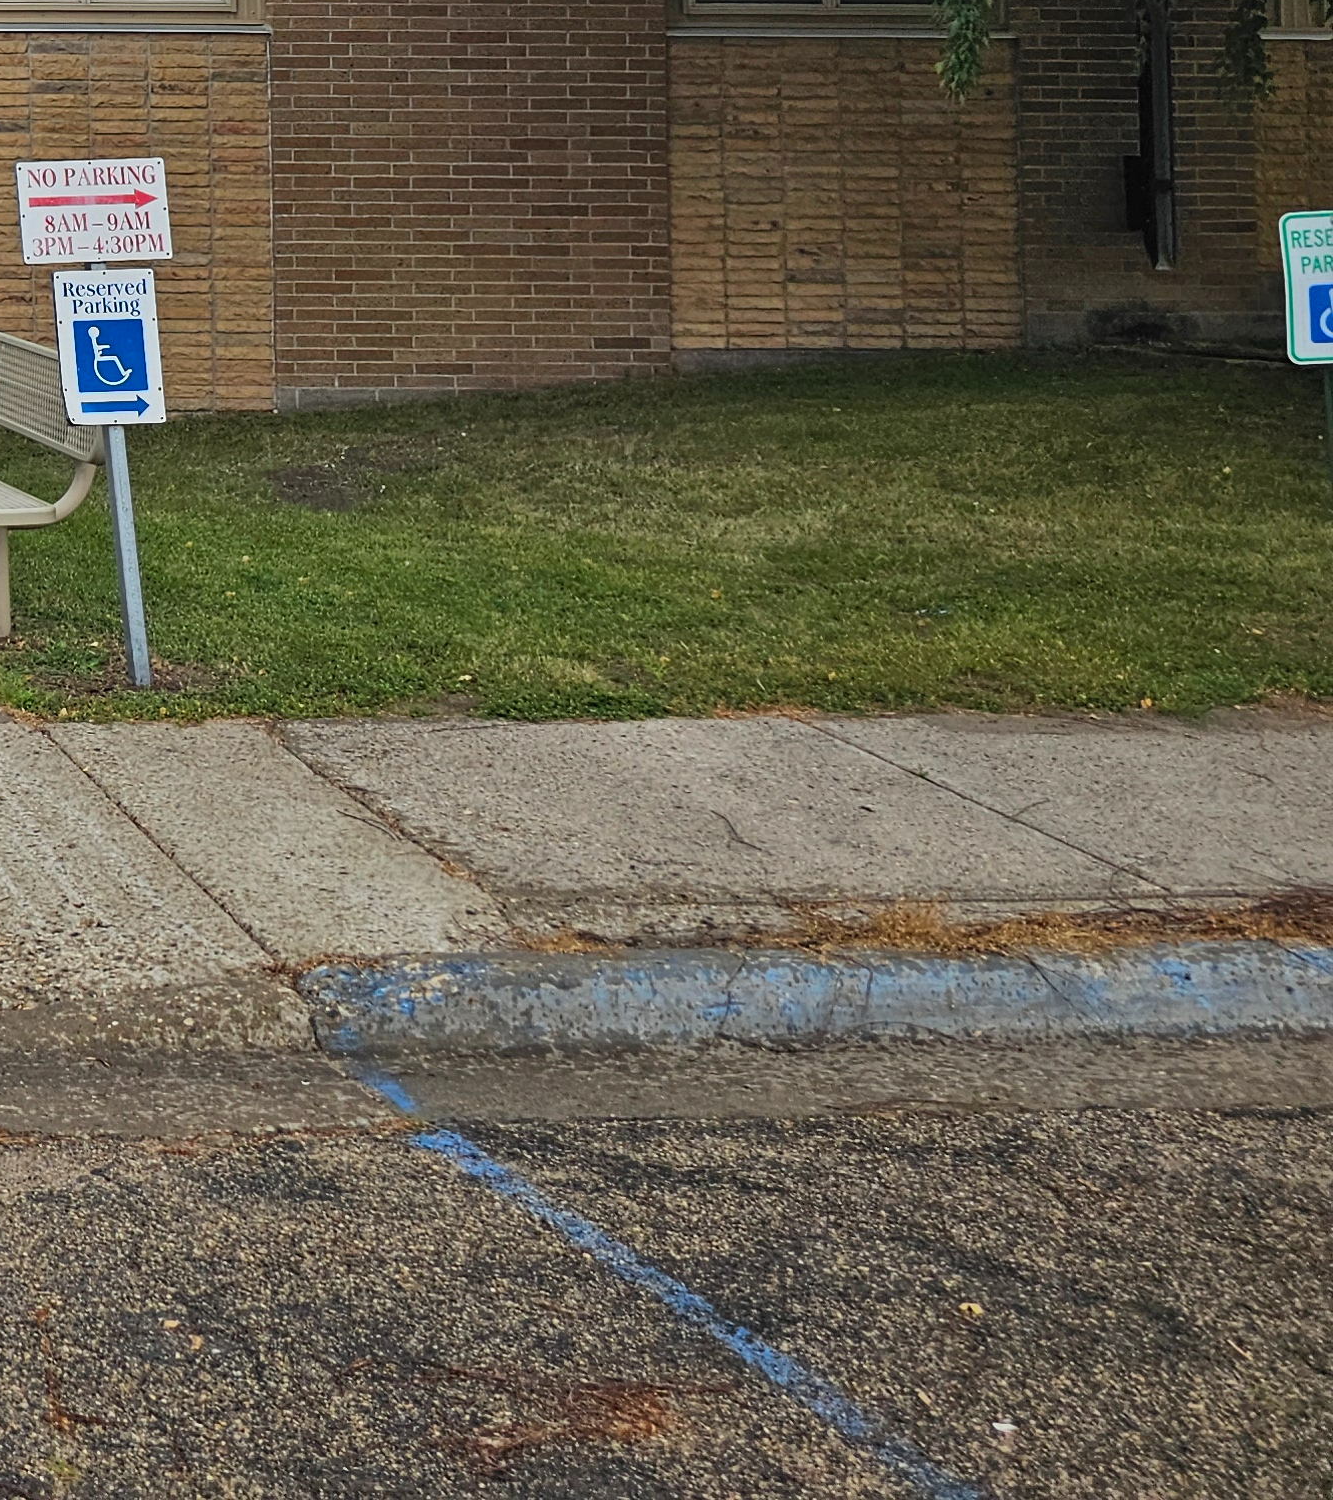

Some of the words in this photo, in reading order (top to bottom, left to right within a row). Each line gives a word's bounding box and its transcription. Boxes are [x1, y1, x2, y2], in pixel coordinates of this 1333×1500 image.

[27, 167, 57, 188] NO
[64, 164, 156, 187] PARKING
[44, 213, 89, 234] 8AM
[107, 211, 151, 232] 9AM
[32, 236, 74, 257] 3PM
[93, 233, 164, 255] 4:30PM
[63, 278, 147, 298] Reserved
[72, 298, 141, 317] Parking
